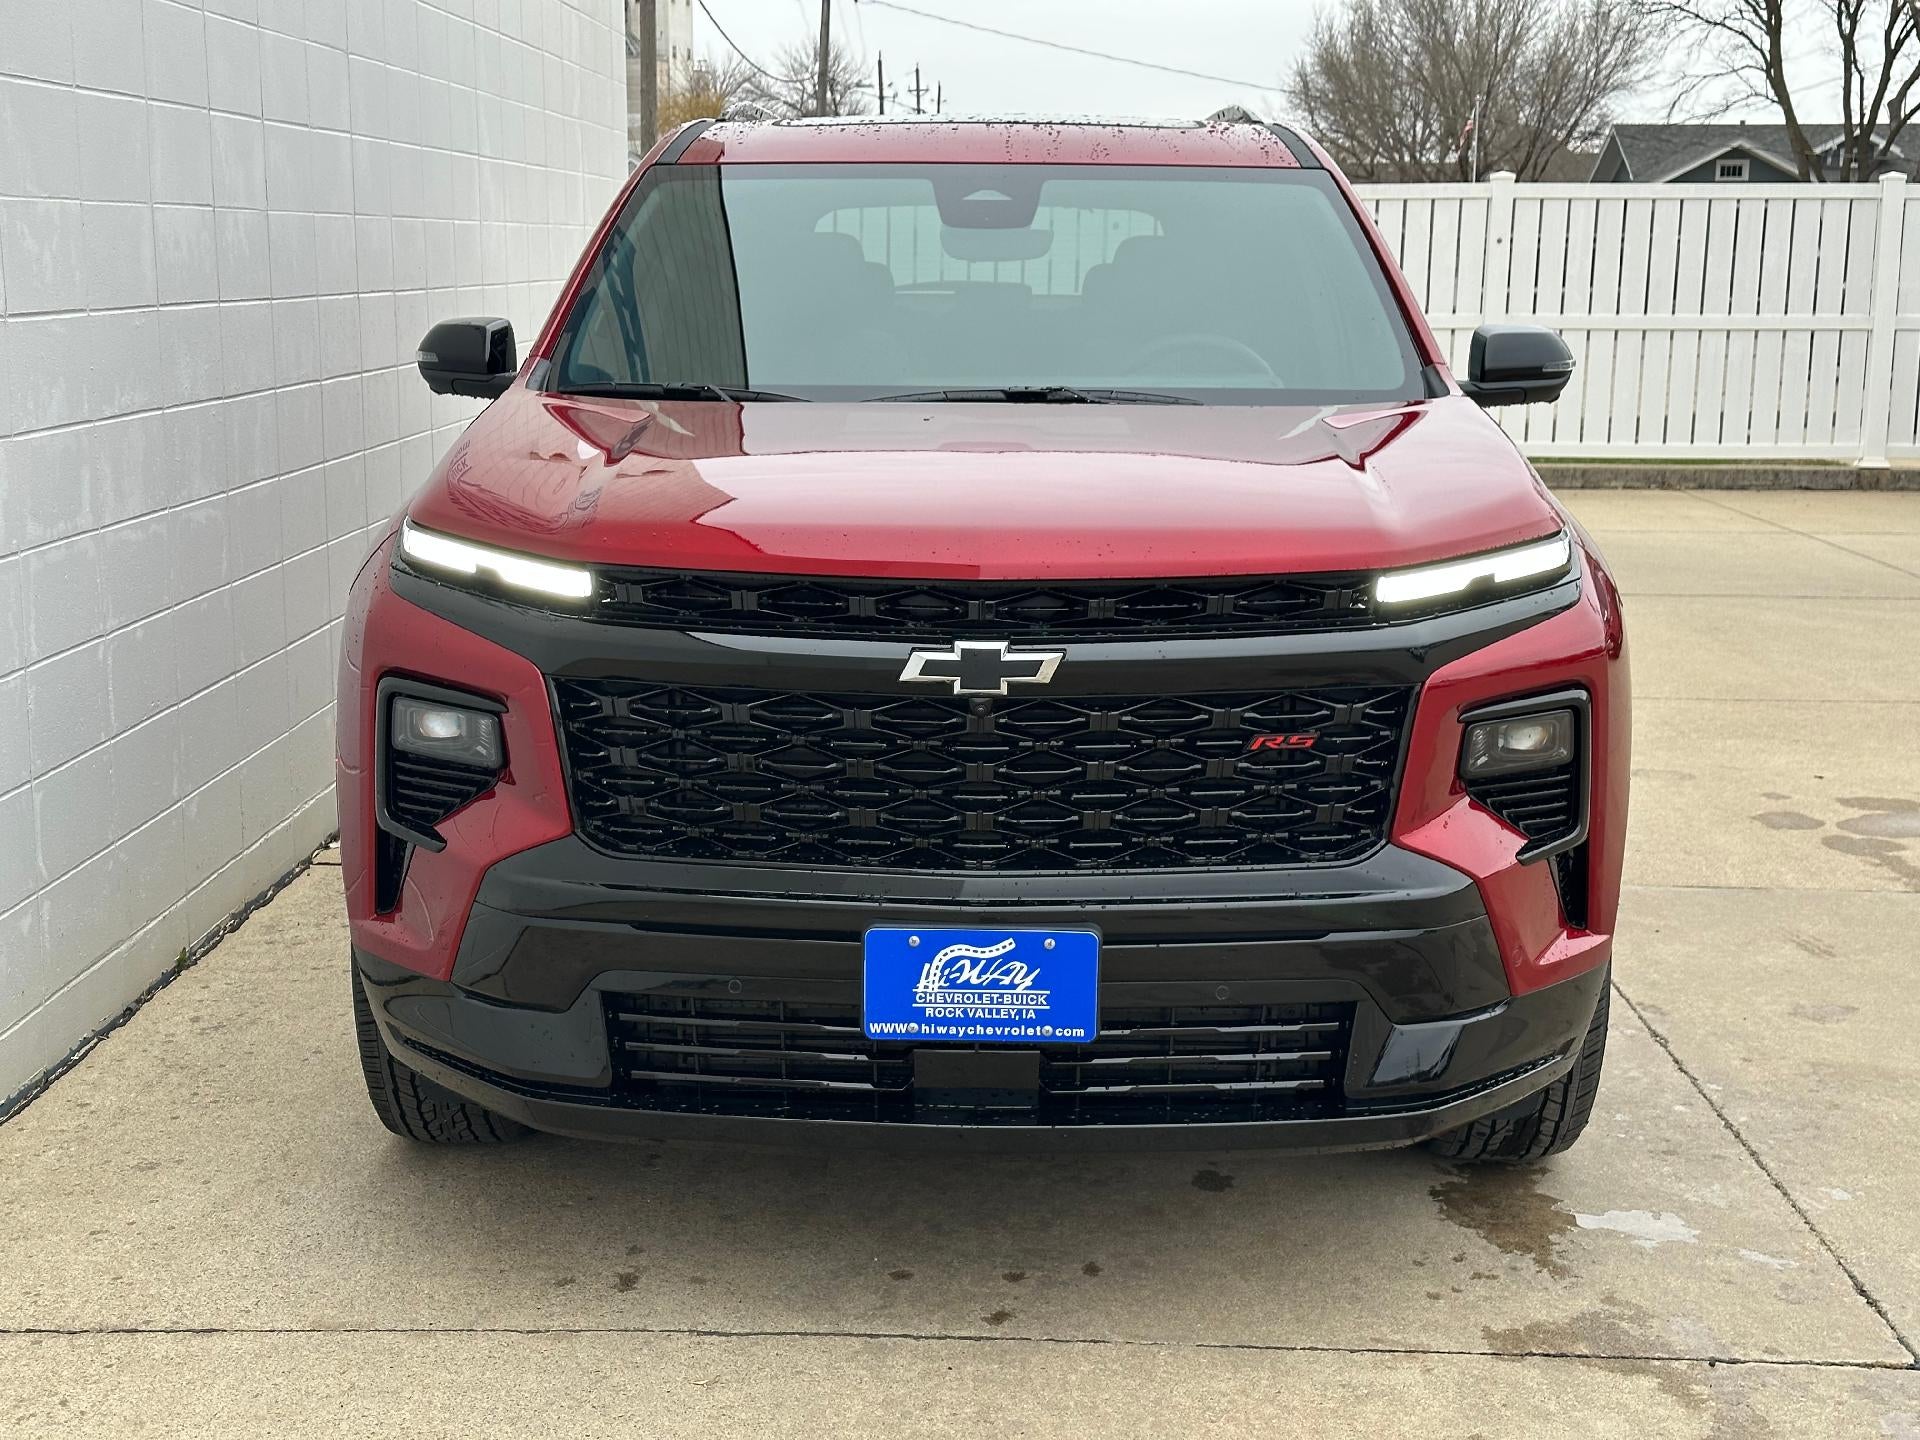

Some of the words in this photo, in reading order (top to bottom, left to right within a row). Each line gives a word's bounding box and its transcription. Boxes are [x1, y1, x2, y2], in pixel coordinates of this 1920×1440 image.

[1249, 735, 1314, 750] RS
[915, 992, 1048, 1006] CHEVROLET-BUICK
[925, 1007, 964, 1018] ROCK
[967, 1007, 1020, 1021] VALLEY,
[1022, 1009, 1036, 1019] IA
